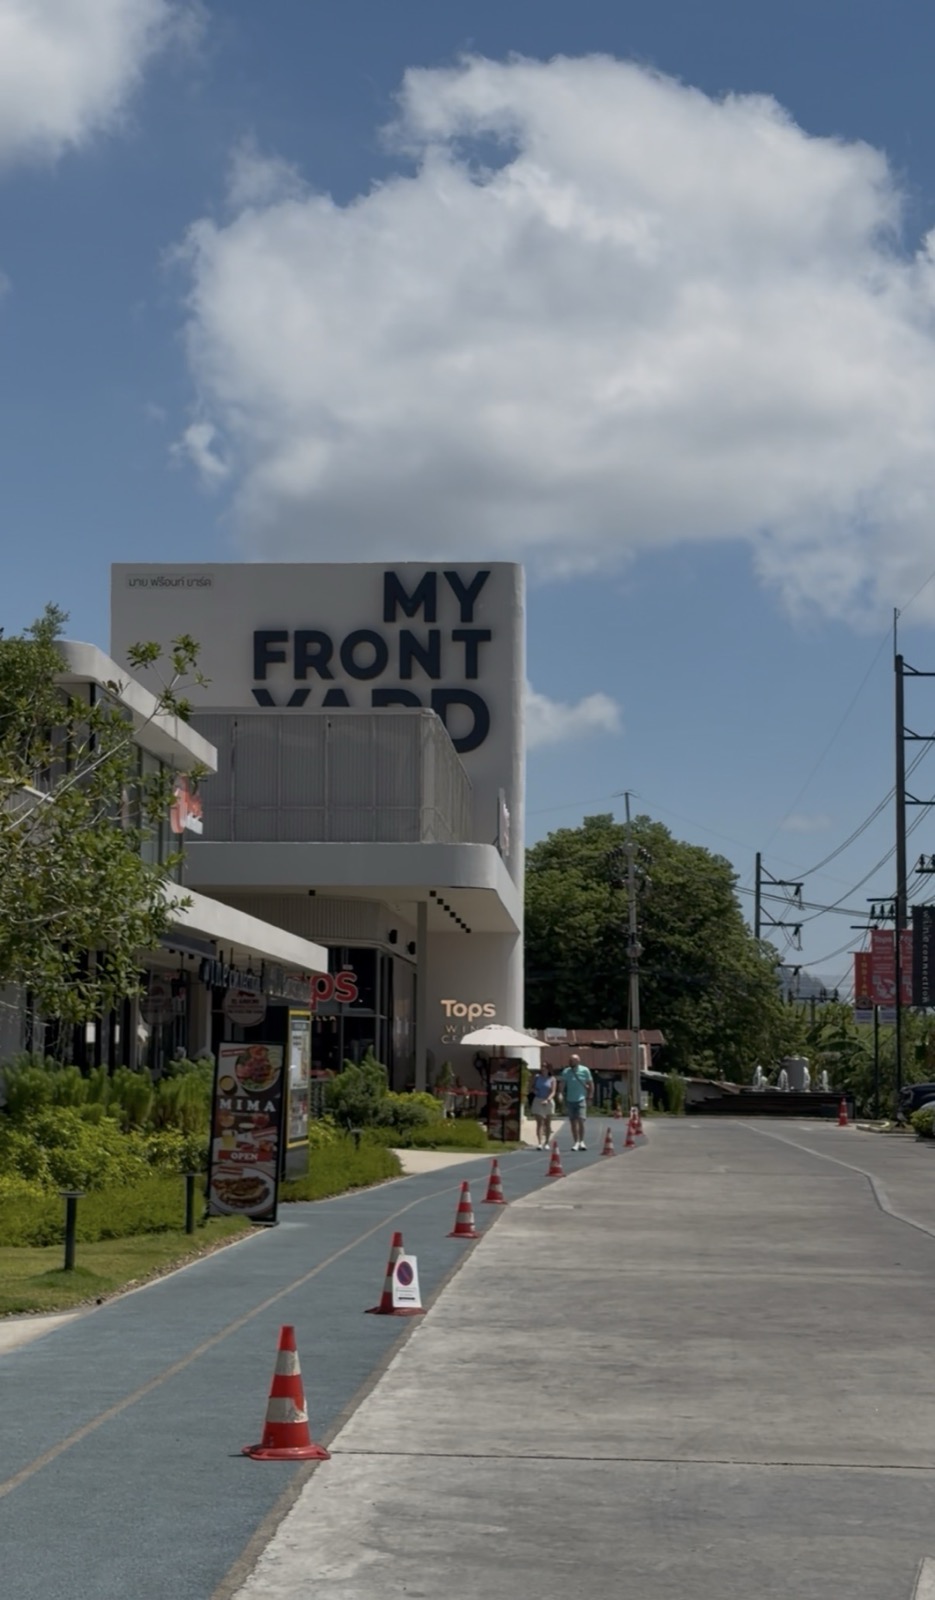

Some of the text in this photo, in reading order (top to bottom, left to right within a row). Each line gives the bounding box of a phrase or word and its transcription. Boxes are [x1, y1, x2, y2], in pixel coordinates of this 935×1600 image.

[383, 571, 490, 623] MY
[253, 629, 492, 680] FRONT
[308, 971, 359, 1011] ps
[440, 999, 497, 1022] Tops
[445, 1025, 482, 1034] WIN
[219, 1098, 276, 1113] MIMA
[230, 1151, 258, 1160] OPEN
